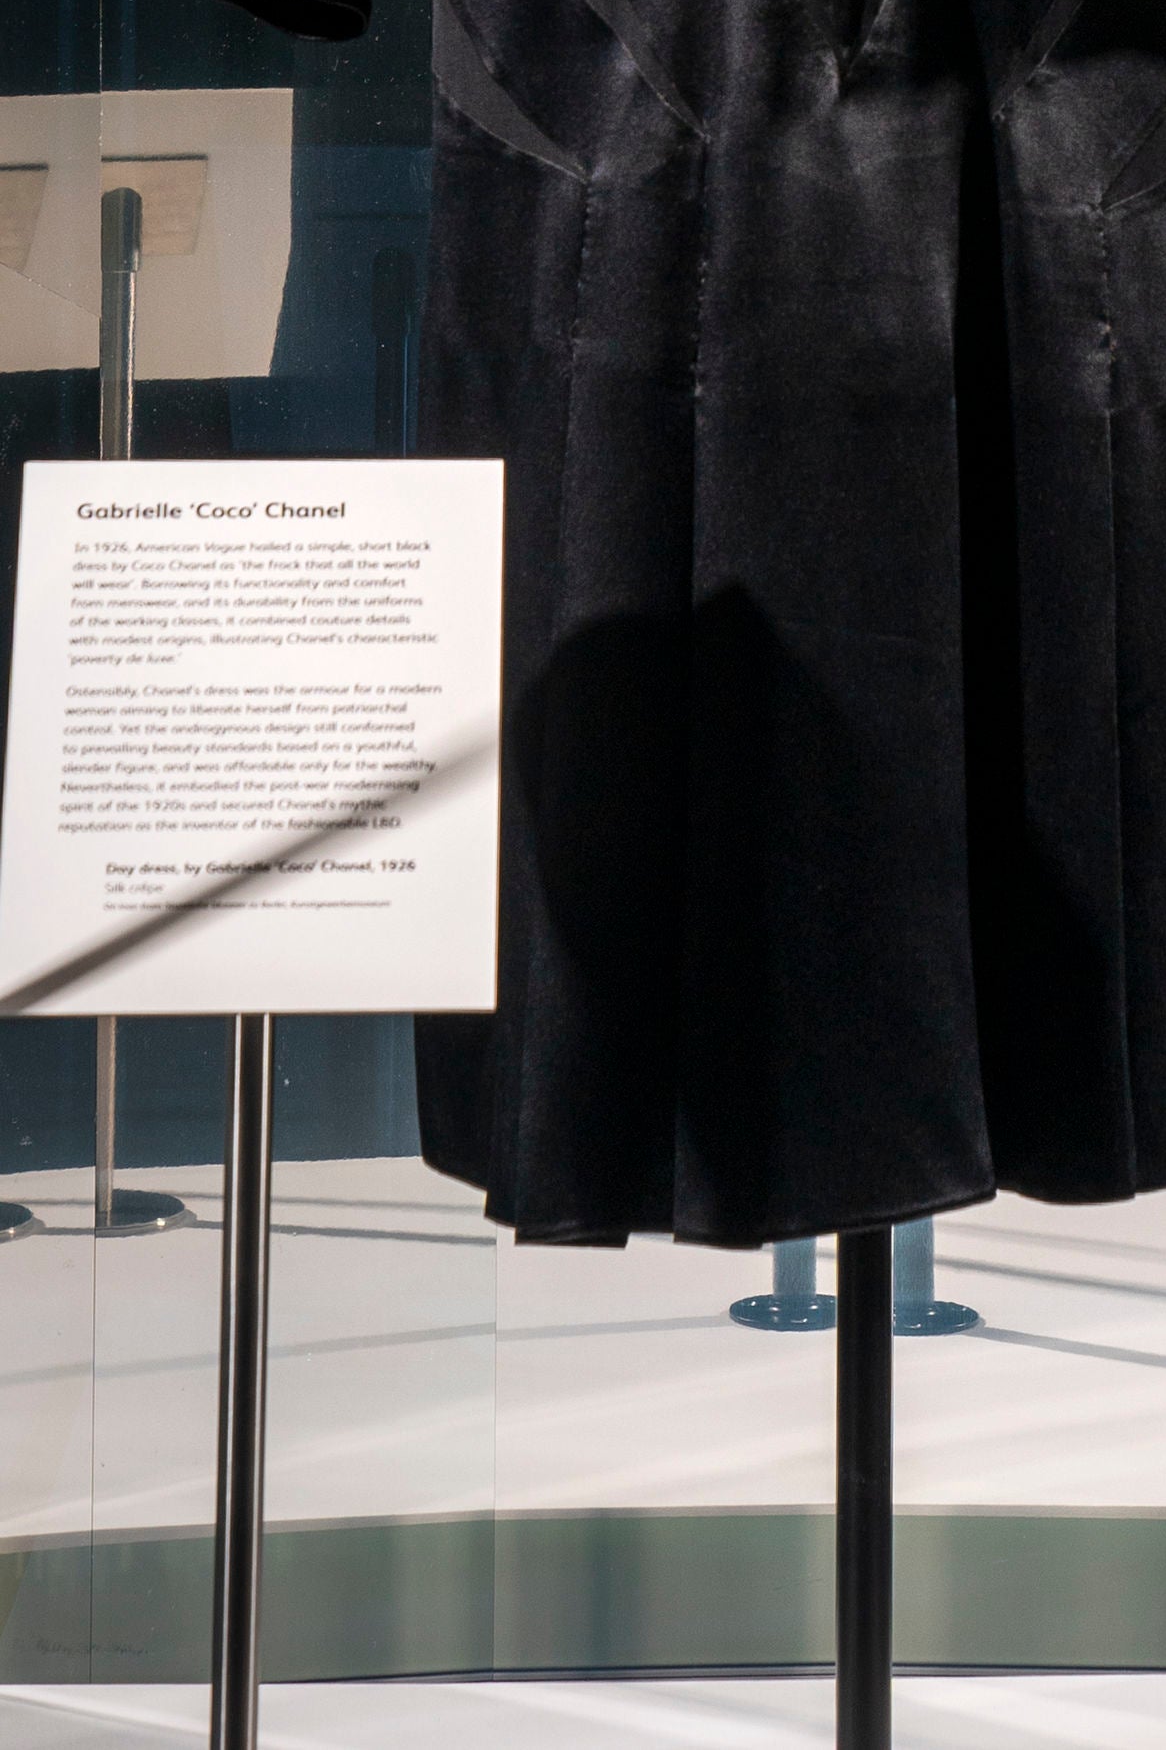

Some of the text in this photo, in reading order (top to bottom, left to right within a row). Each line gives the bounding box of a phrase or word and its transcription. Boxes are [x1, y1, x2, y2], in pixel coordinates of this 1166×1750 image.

[77, 502, 182, 519] Gabrielle
[265, 502, 346, 518] Chanel
[75, 541, 90, 552] In
[135, 541, 201, 552] American
[204, 541, 246, 554] Vogue
[249, 541, 292, 552] hailed
[294, 544, 304, 552] a
[358, 541, 392, 552] short
[396, 541, 431, 552] black
[72, 560, 108, 571] dress
[111, 560, 128, 573] by
[131, 560, 165, 571] Coco
[168, 559, 217, 570] Chanel
[219, 562, 235, 570] as
[268, 559, 301, 570] frock
[305, 559, 334, 570] that
[337, 559, 354, 570] all
[357, 559, 380, 570] the
[383, 559, 421, 570] world
[72, 578, 95, 589] will
[141, 578, 211, 592] Borrowing
[213, 578, 230, 589] its
[233, 578, 320, 591] functionality
[323, 577, 351, 588] and
[353, 577, 406, 588] comfort
[70, 597, 104, 608] from
[183, 596, 211, 607] and
[213, 596, 230, 607] its
[233, 596, 298, 610] durability
[301, 596, 335, 607] from
[337, 596, 361, 607] the
[364, 595, 424, 606] uniforms
[69, 616, 85, 627] of
[88, 616, 111, 627] the
[114, 615, 169, 629] working
[226, 615, 235, 626] it
[239, 615, 308, 626] combined
[310, 614, 363, 625] couture
[366, 614, 411, 625] details
[69, 634, 99, 645] with
[102, 634, 154, 645] modest
[209, 633, 284, 647] illustrating
[347, 633, 438, 644] characteristic
[126, 652, 144, 663] de
[204, 685, 240, 696] dress
[243, 687, 270, 695] was
[273, 684, 297, 695] the
[299, 687, 350, 695] armour
[354, 684, 372, 695] for
[376, 687, 386, 695] a
[388, 683, 443, 694] modern
[65, 703, 408, 718] woman aiming to liberate herself from patriarchal
[119, 723, 141, 734] Yet
[144, 723, 168, 734] the
[171, 722, 262, 736] androgynous
[264, 722, 311, 735] design
[314, 722, 338, 733] still
[341, 721, 416, 732] conformed
[62, 743, 78, 754] to
[81, 743, 150, 756] prevailing
[152, 742, 202, 756] beauty
[205, 742, 274, 753] standards
[276, 741, 319, 752] based
[322, 744, 340, 752] on
[343, 744, 353, 752] a
[62, 762, 112, 773] slender
[163, 761, 191, 772] and
[194, 764, 221, 772] was
[224, 761, 296, 772] affordable
[300, 760, 329, 774] only
[332, 760, 351, 771] for
[355, 760, 378, 771] the
[156, 781, 166, 792] it
[170, 780, 241, 791] embodied
[243, 780, 267, 791] the
[270, 780, 330, 793] post-war
[60, 801, 94, 814] spirit
[98, 801, 113, 812] of
[116, 800, 140, 811] the
[145, 800, 187, 811] 1920s
[190, 800, 218, 811] and
[221, 799, 275, 810] secured
[339, 798, 386, 812] mythic
[58, 821, 133, 834] reputation
[136, 823, 152, 831] as
[155, 820, 179, 831] the
[182, 819, 239, 830] inventor
[243, 819, 257, 830] of
[261, 819, 284, 830] the
[288, 818, 369, 829] fashionable
[106, 862, 135, 876] Day
[184, 861, 201, 875] by
[206, 861, 271, 872] Gabrielle
[381, 860, 416, 871] 1926
